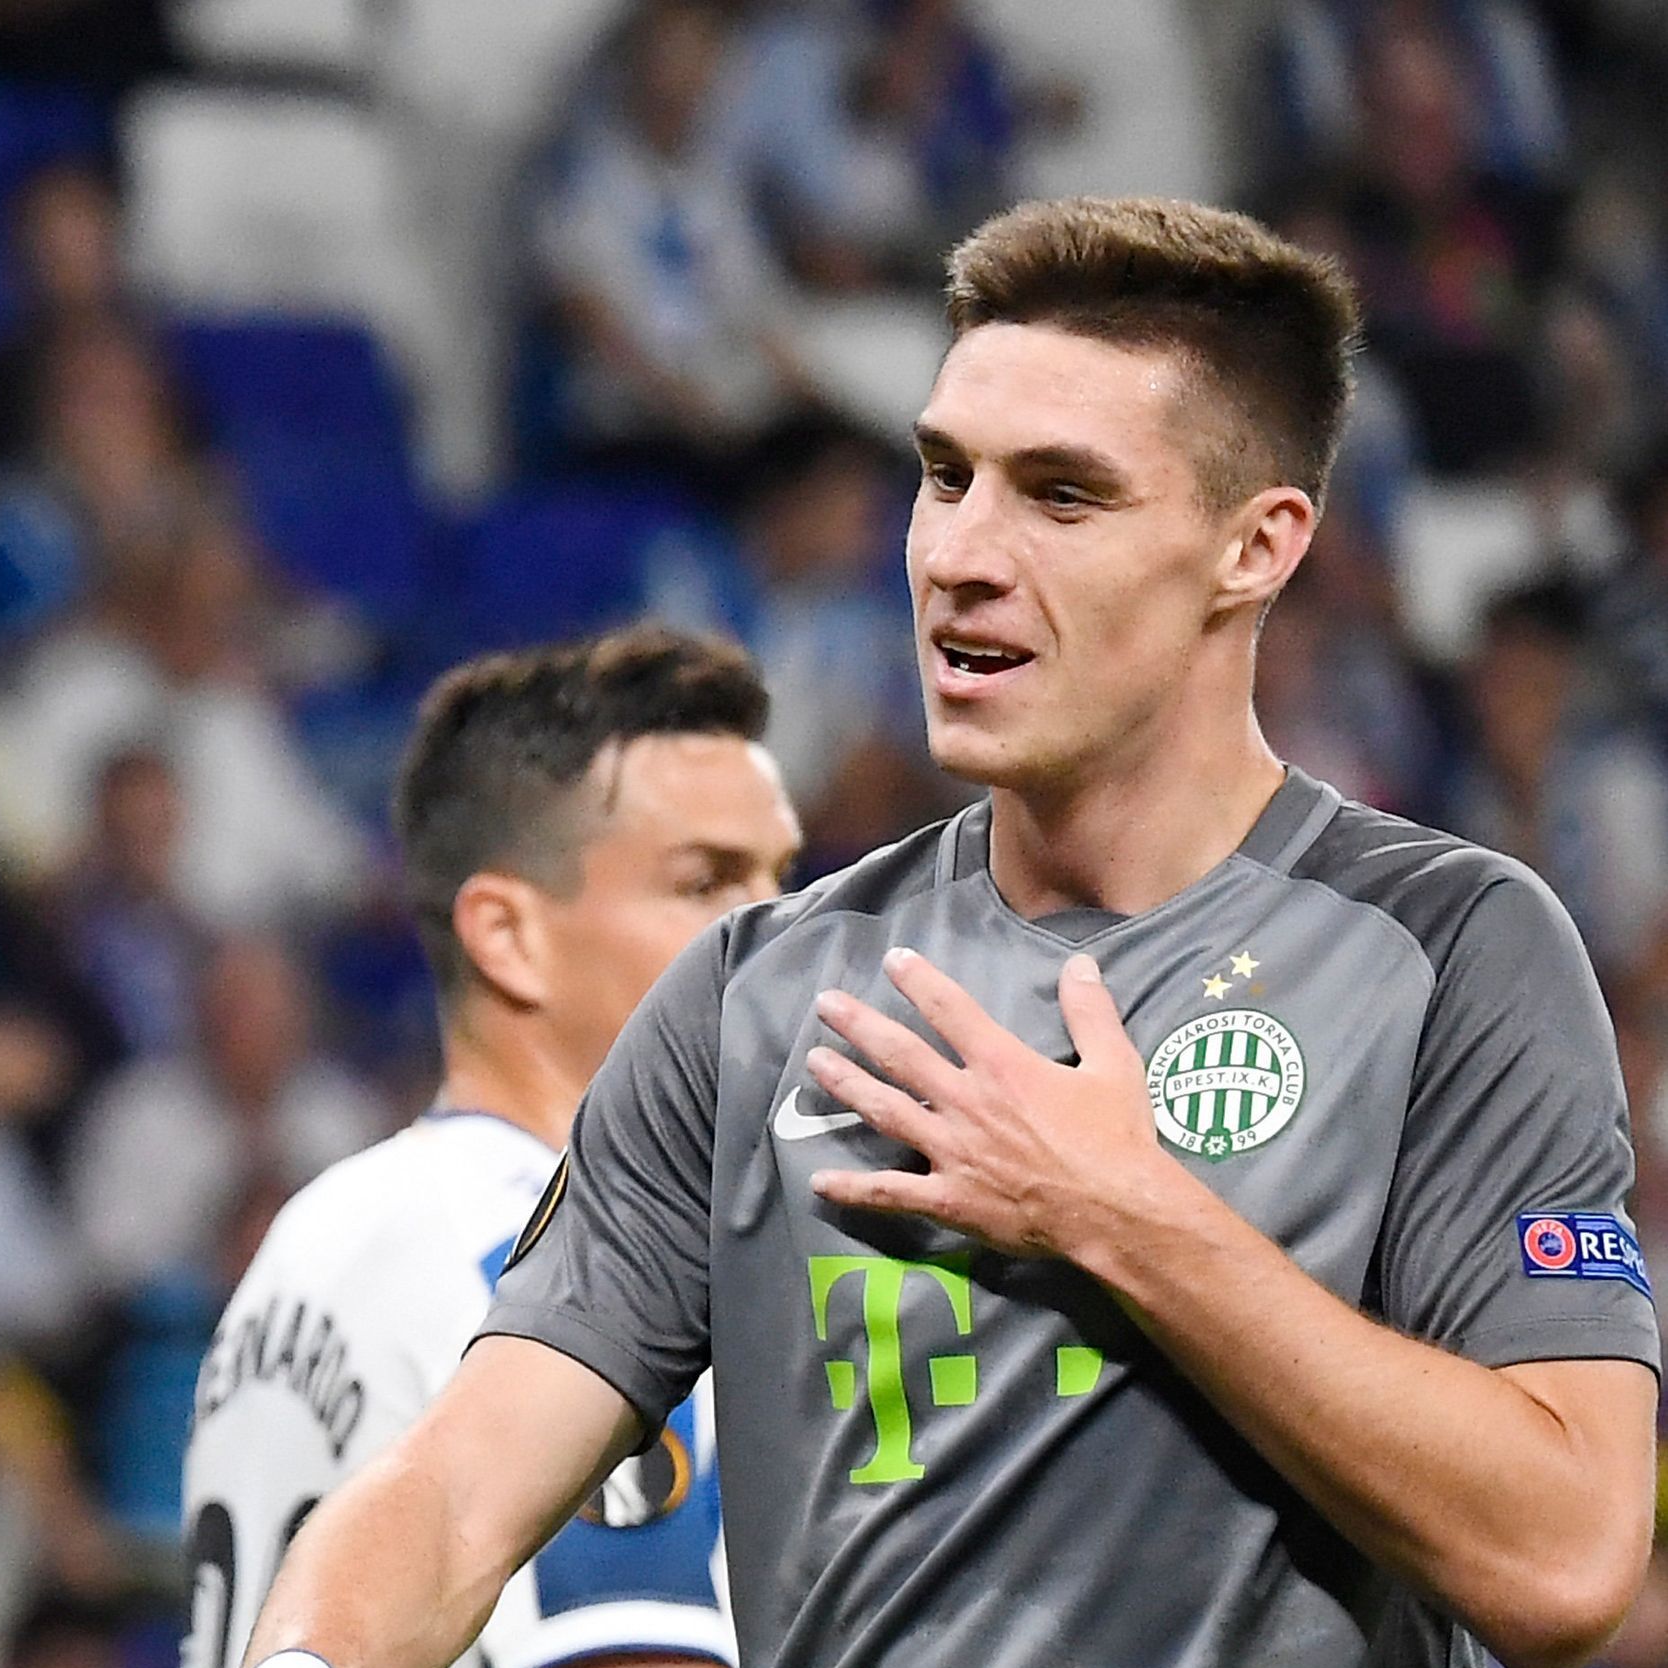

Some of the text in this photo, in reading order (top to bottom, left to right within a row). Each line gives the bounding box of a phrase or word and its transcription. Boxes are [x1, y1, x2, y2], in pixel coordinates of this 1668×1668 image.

[1149, 1014, 1300, 1108] FERENCVÁROSI TORNA CLUB
[1178, 1130, 1257, 1149] 18 99
[808, 1255, 977, 1485] T
